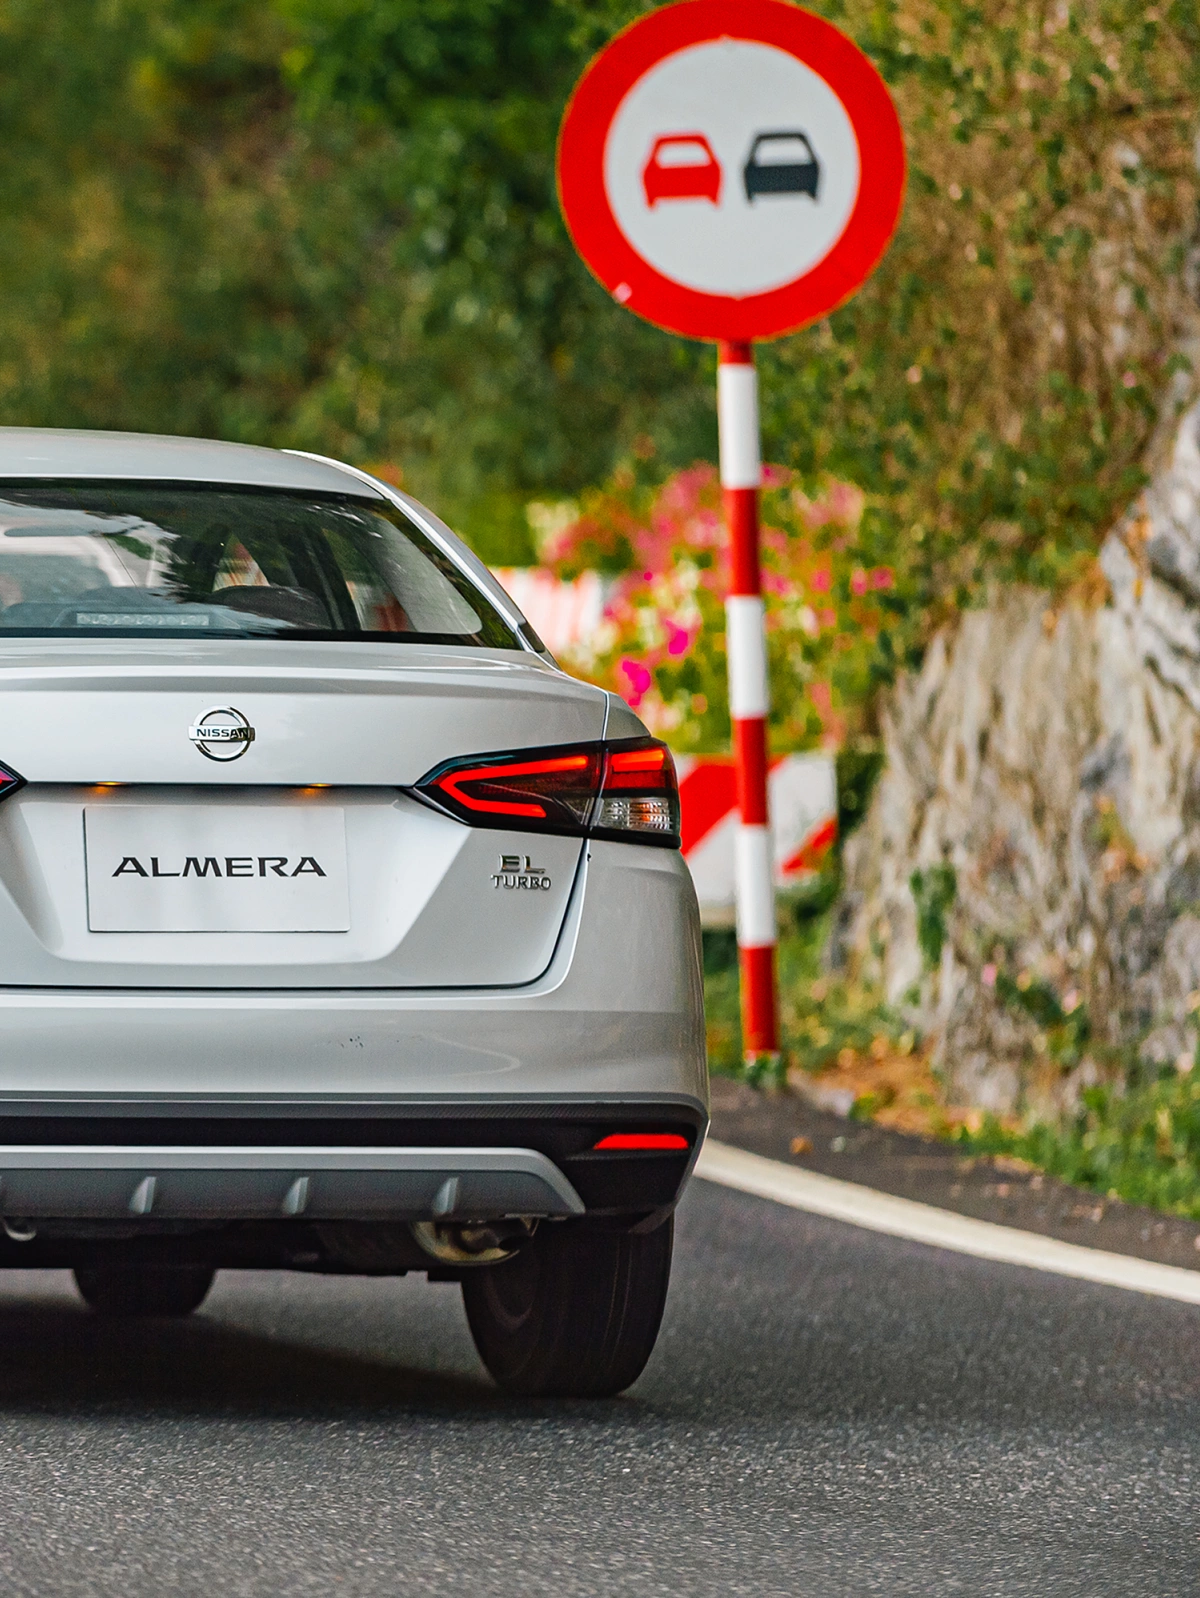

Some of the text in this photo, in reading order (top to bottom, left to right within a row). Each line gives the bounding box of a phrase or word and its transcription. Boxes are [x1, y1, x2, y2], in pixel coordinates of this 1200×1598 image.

[196, 728, 249, 739] NISSAN
[112, 857, 327, 877] ALMERA
[499, 854, 546, 873] EL
[490, 875, 552, 890] TURBO
